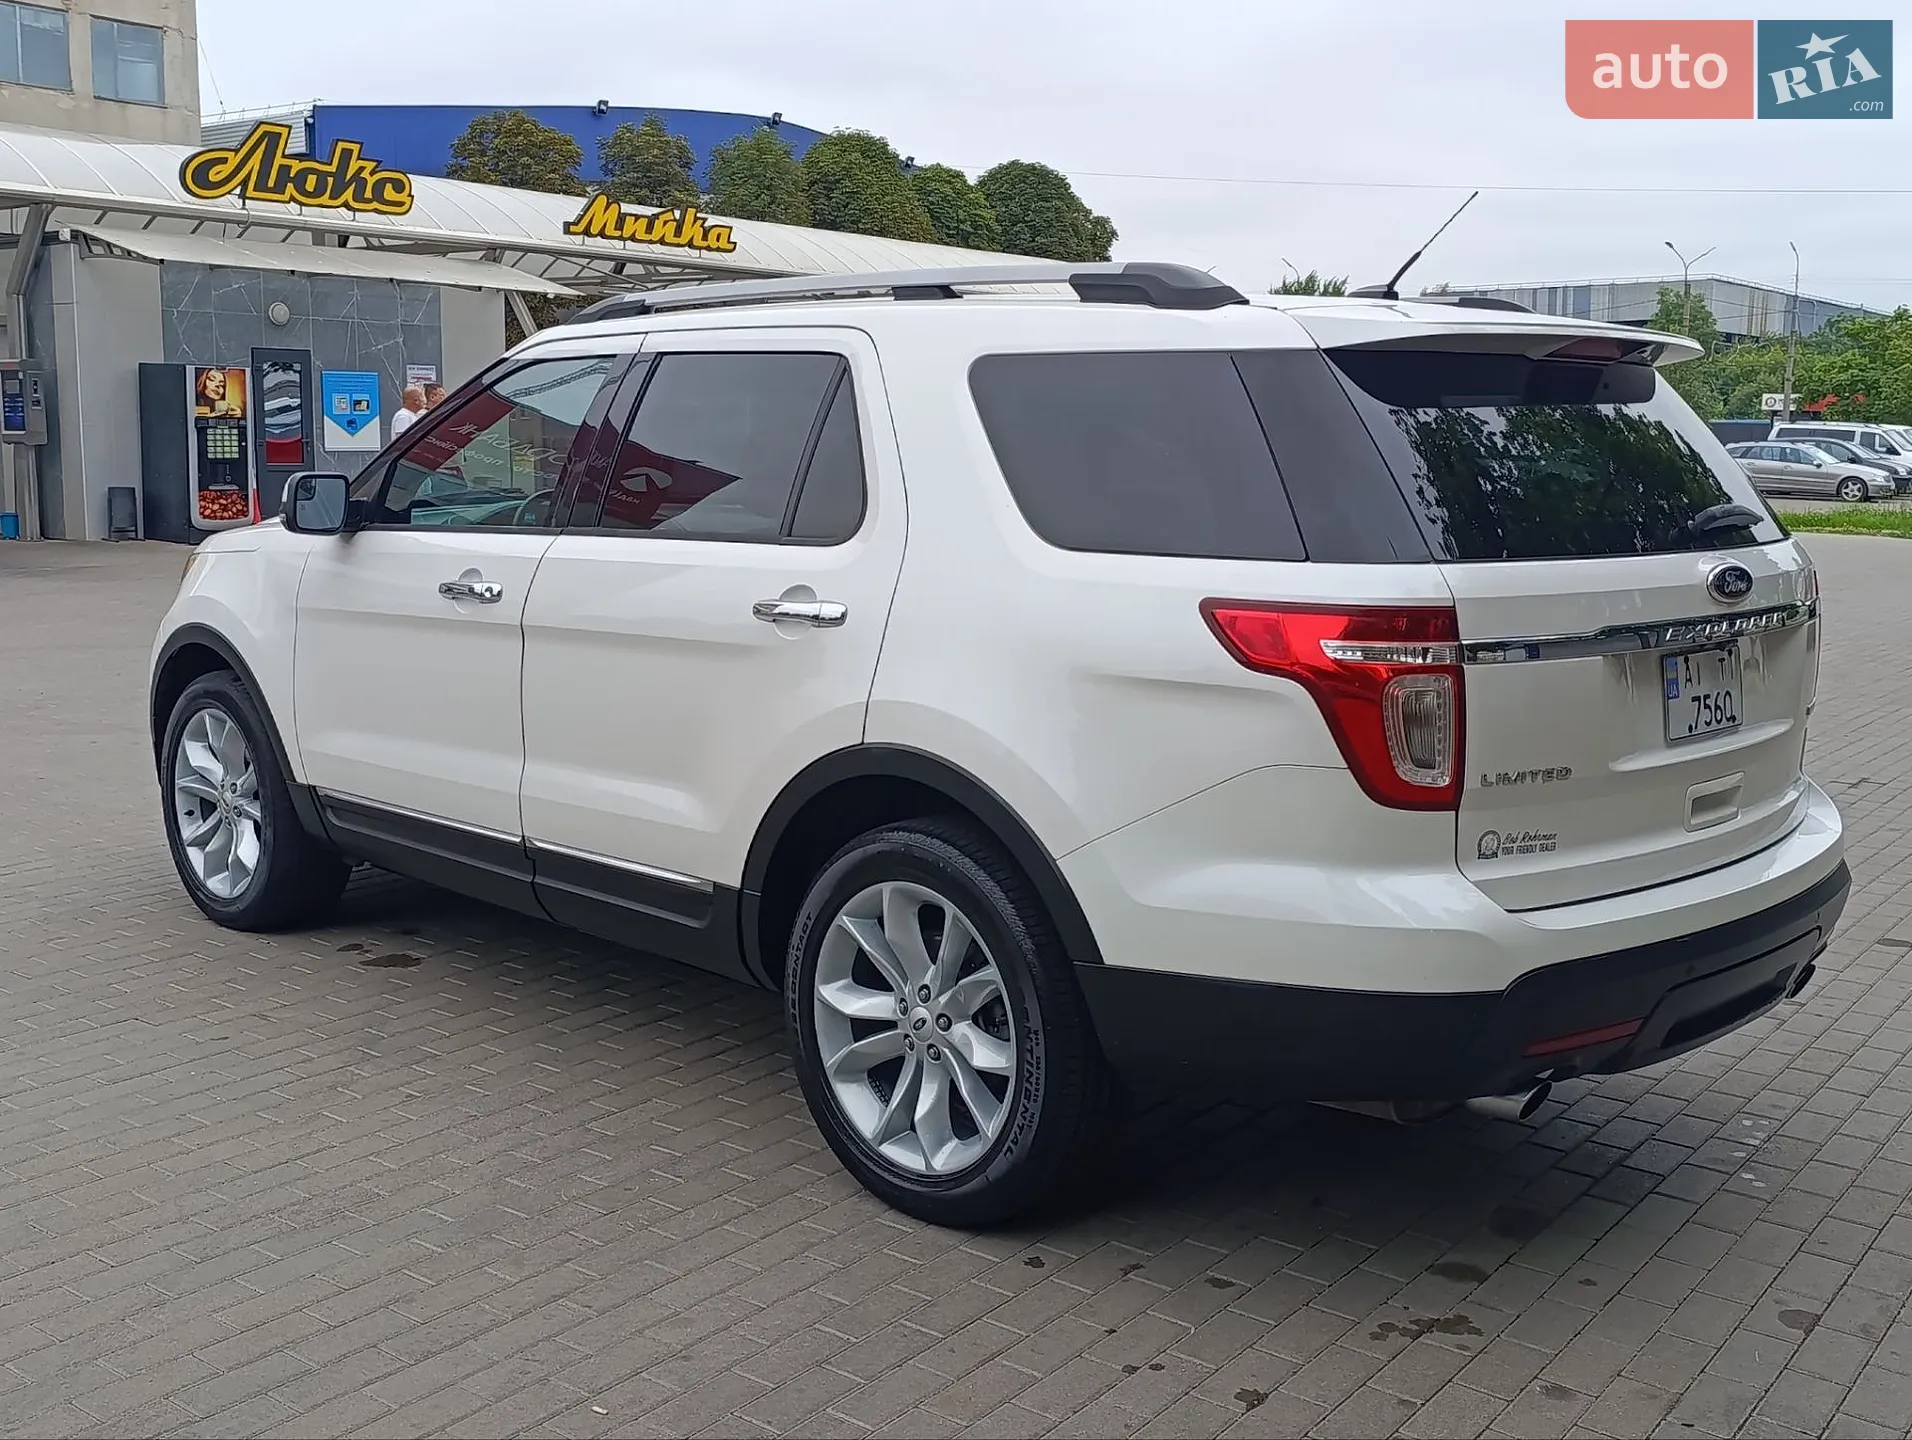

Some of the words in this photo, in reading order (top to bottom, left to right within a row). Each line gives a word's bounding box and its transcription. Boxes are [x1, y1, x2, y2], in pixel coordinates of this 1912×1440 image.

[179, 121, 414, 215] Люкс
[563, 192, 738, 253] Мийка
[1724, 570, 1748, 593] Ford
[1665, 611, 1784, 642] EXPLORER
[1668, 685, 1679, 697] UA
[1691, 690, 1733, 730] 7560
[1481, 767, 1572, 787] LIMITED
